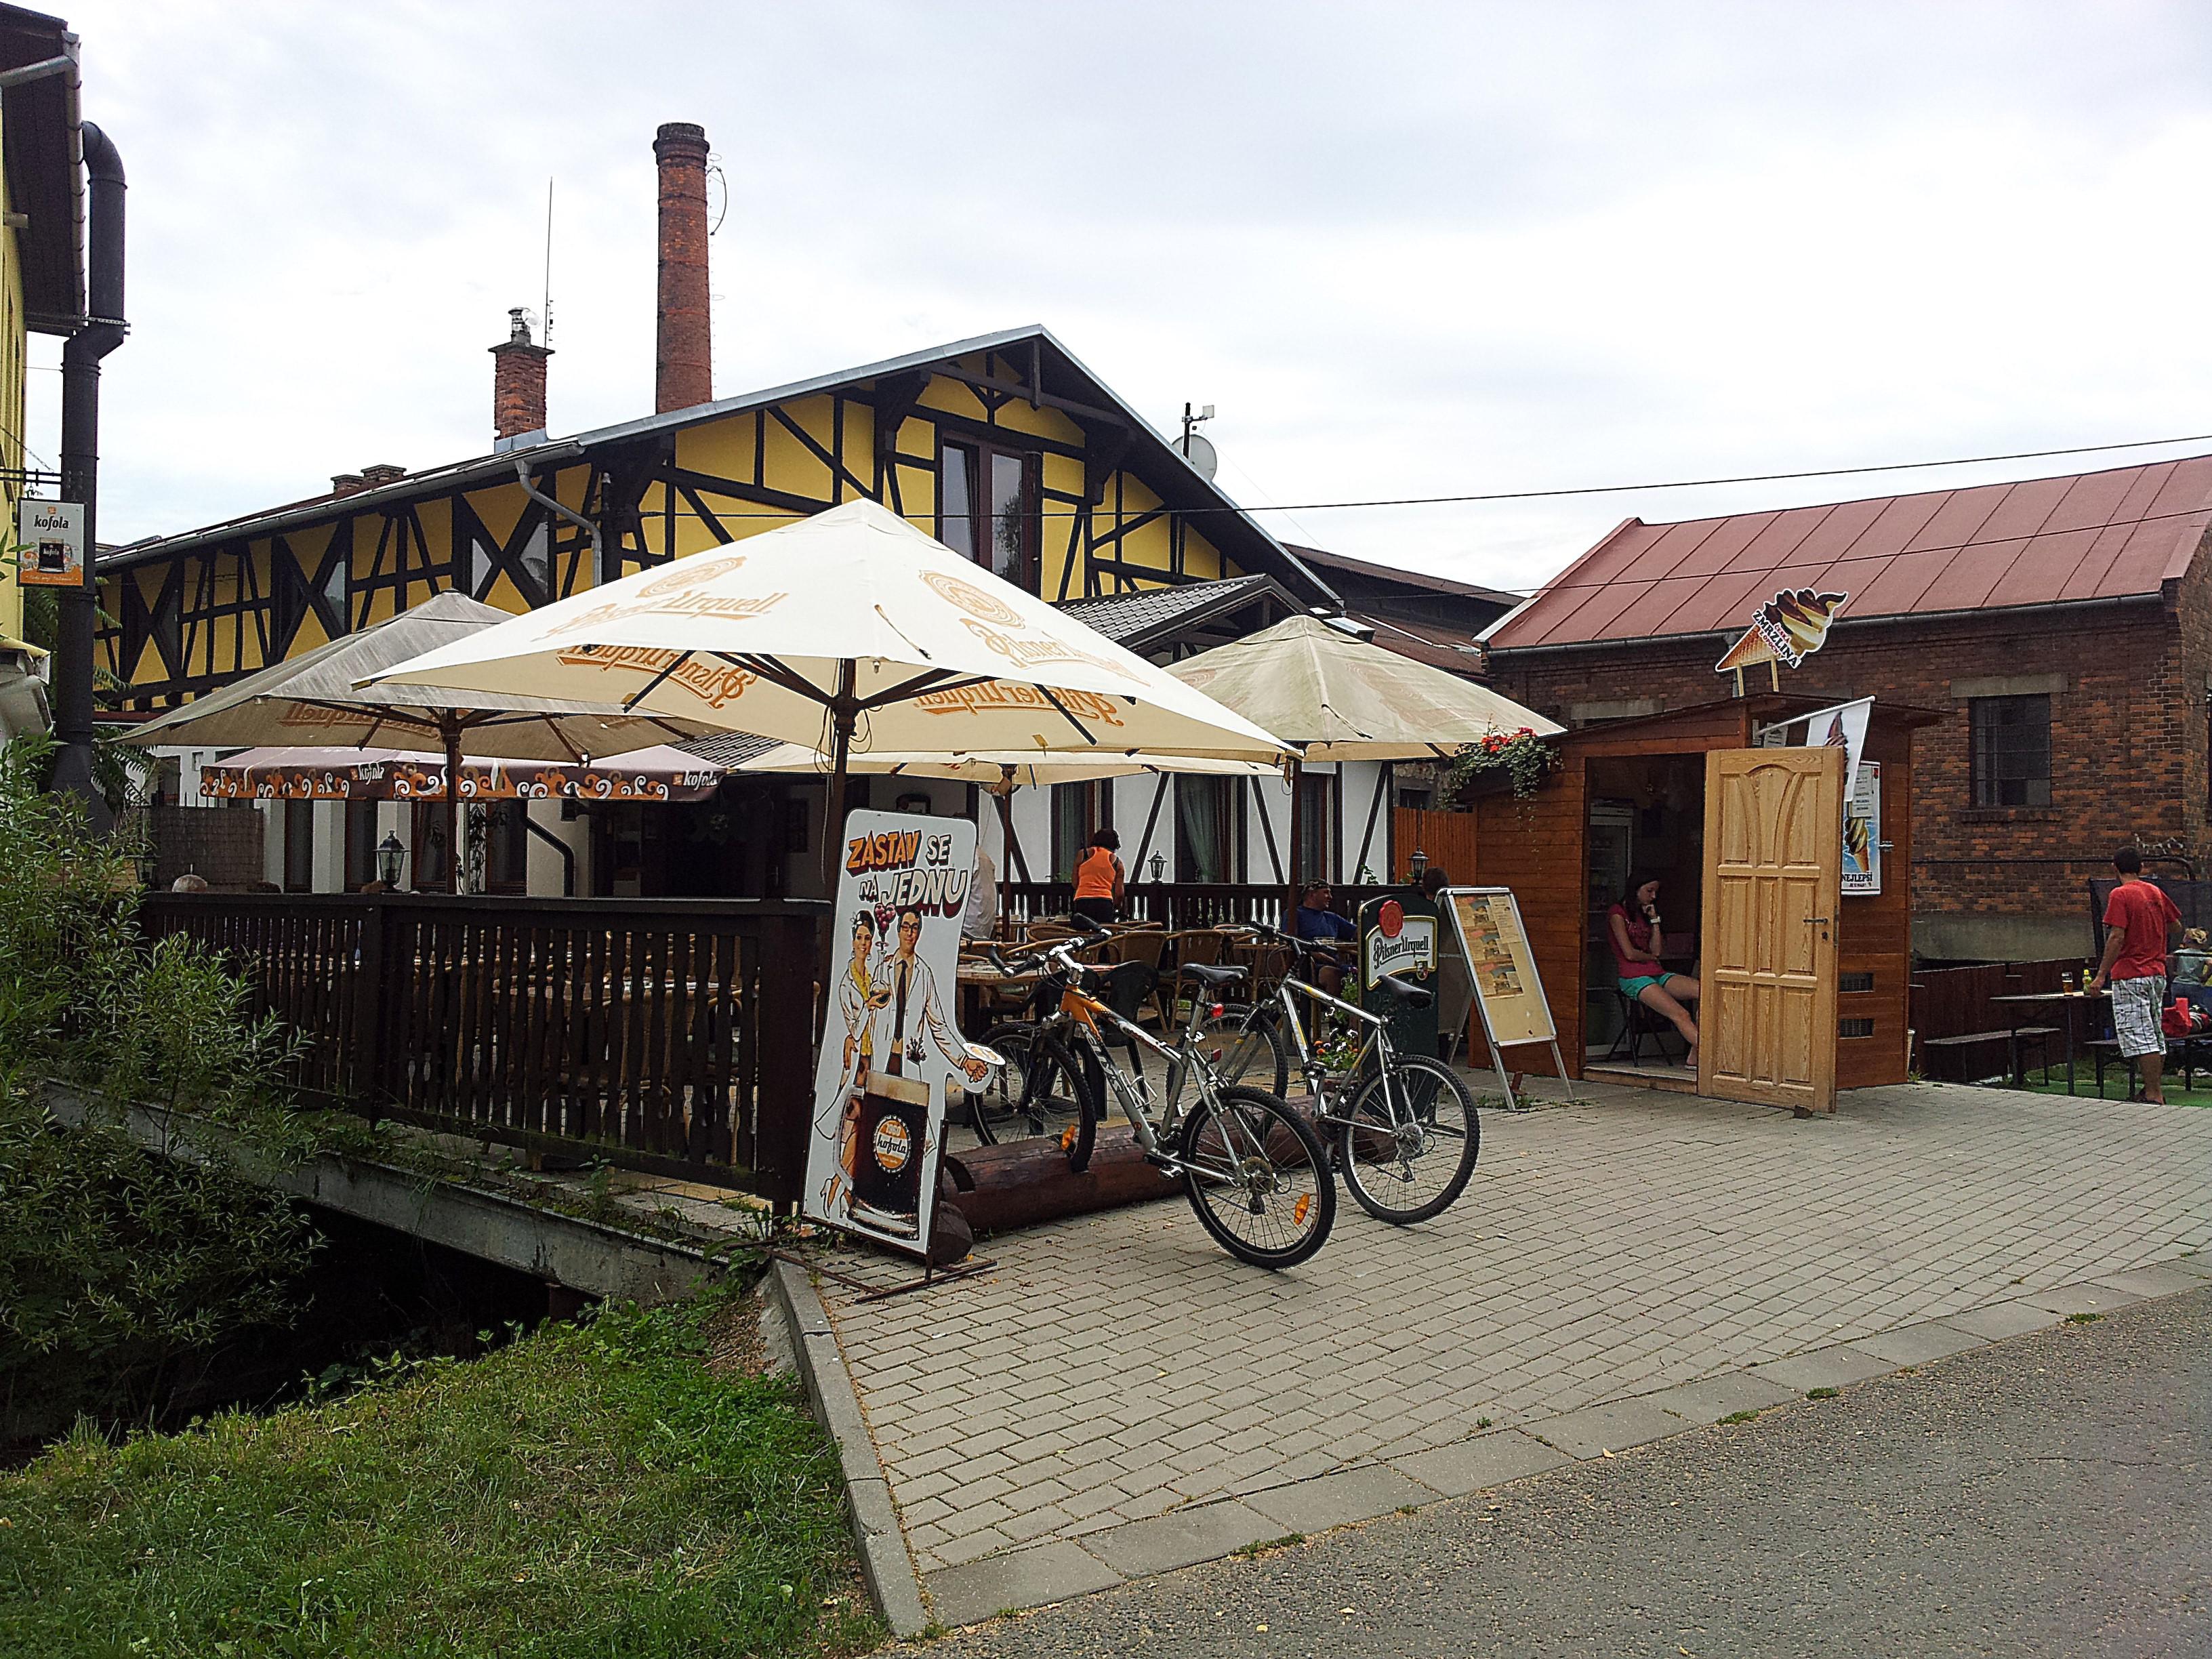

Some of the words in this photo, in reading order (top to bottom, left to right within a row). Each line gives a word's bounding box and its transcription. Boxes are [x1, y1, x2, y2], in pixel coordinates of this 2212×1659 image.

[34, 514, 69, 531] kofola
[660, 590, 789, 619] Urquell
[1752, 610, 1799, 668] ZMRZLINA
[682, 770, 718, 791] kofola
[846, 828, 922, 877] ZASTAV
[926, 834, 952, 867] SE
[858, 874, 880, 902] NA
[881, 867, 968, 918] JEDNU
[1373, 937, 1402, 970] Pilsner
[1400, 935, 1429, 958] Urquell
[876, 1134, 906, 1153] kofola
